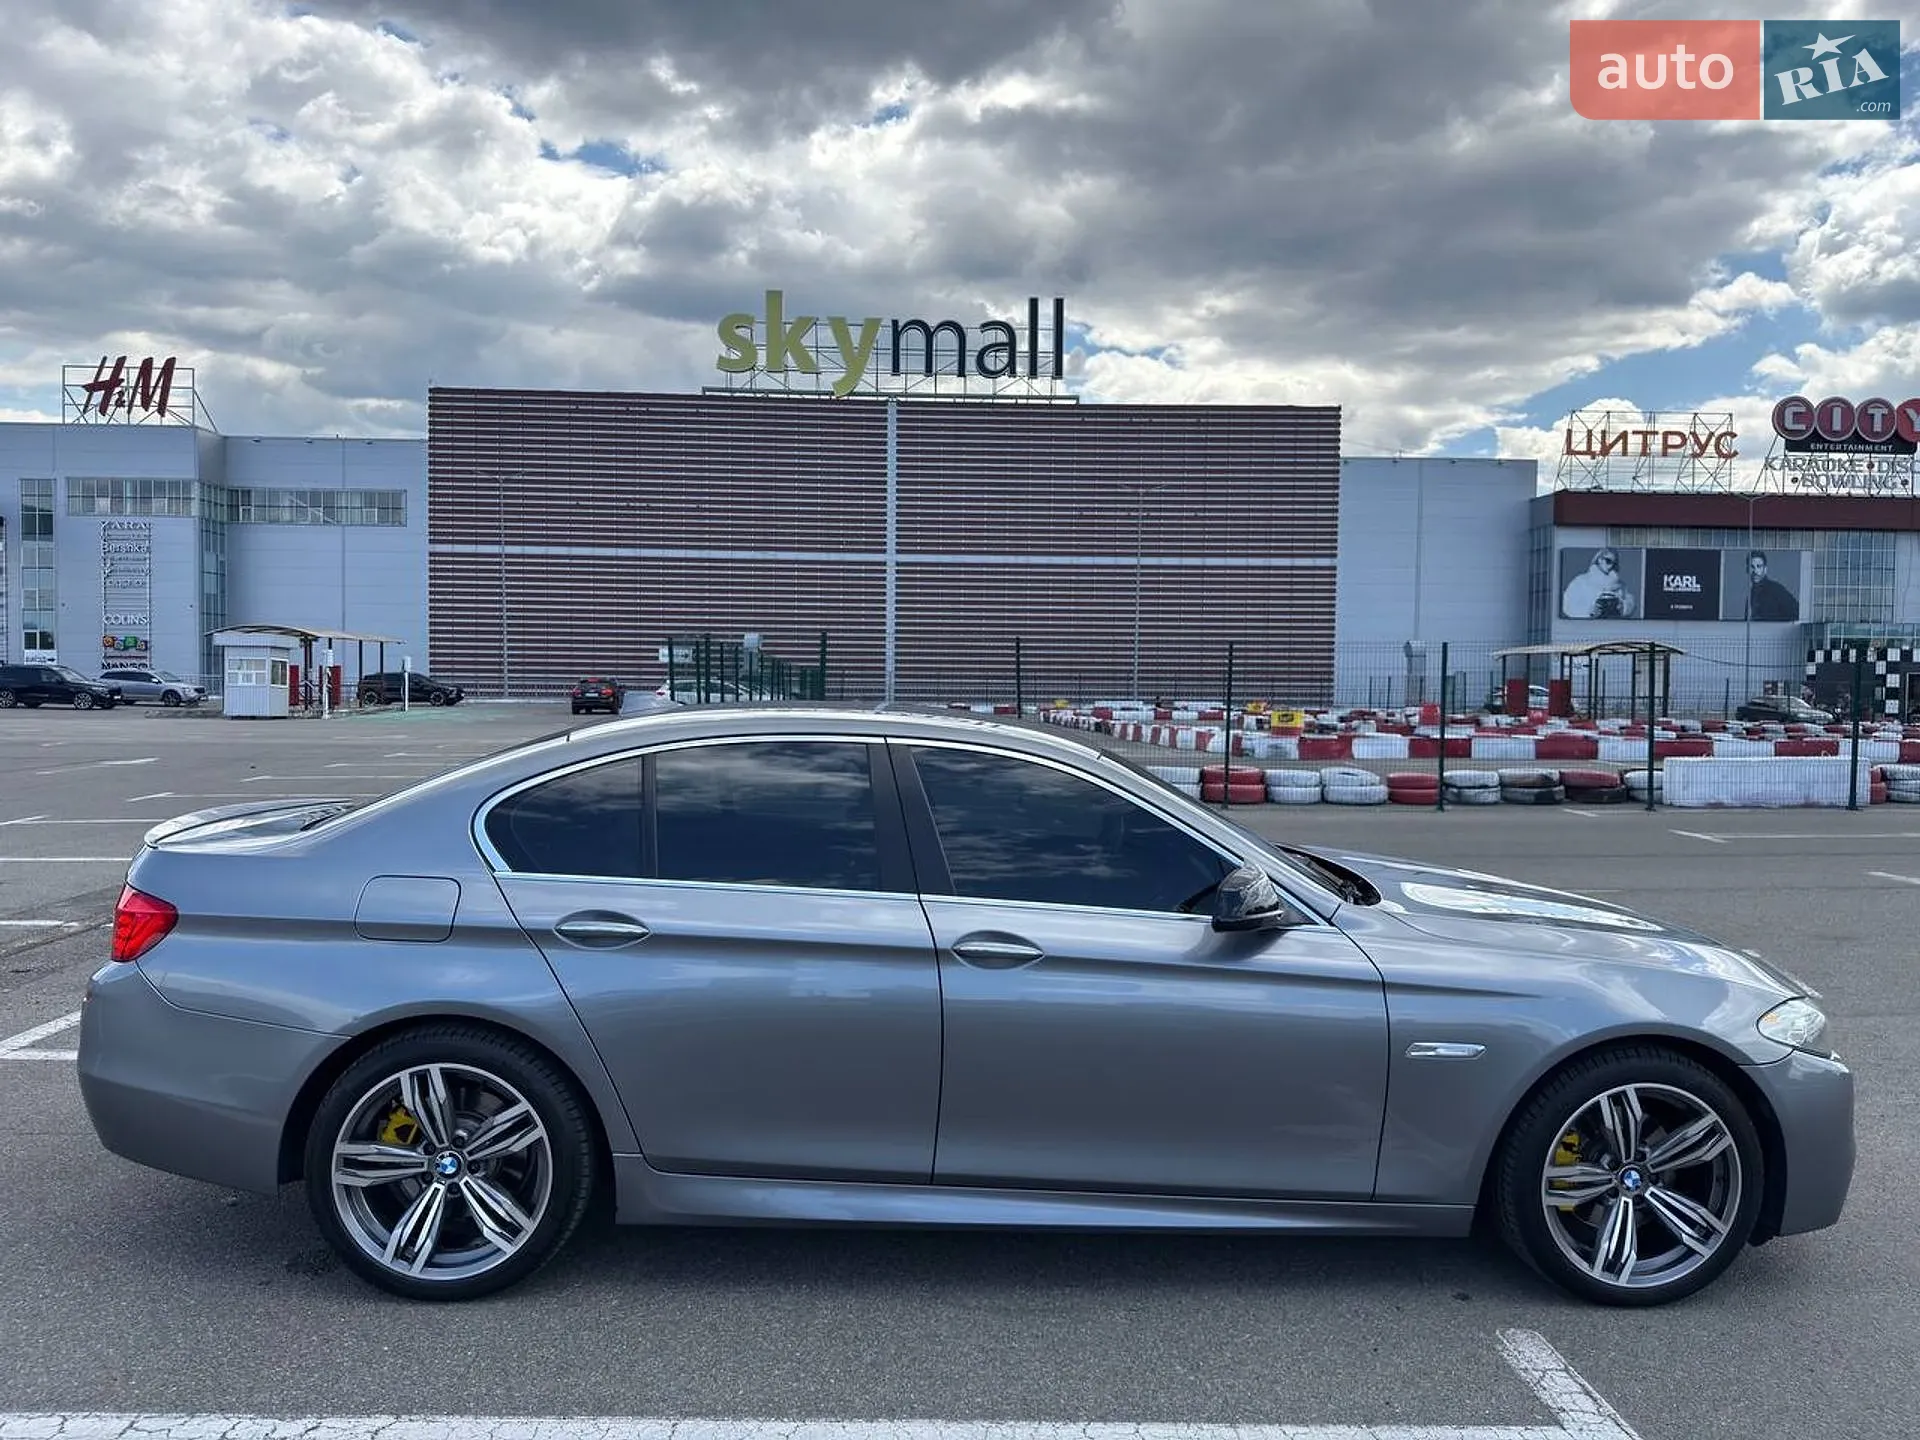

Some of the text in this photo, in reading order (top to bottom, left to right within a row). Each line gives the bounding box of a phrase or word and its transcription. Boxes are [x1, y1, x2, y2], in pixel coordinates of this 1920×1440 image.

[716, 290, 1065, 398] skymall
[82, 355, 176, 418] H&M
[1563, 428, 1739, 460] ЦИТРУС
[1810, 443, 1894, 452] ENTERTAINMENT
[1765, 457, 1864, 472] KARAOKE
[1801, 474, 1898, 490] BOWLING
[1663, 574, 1701, 588] KARL
